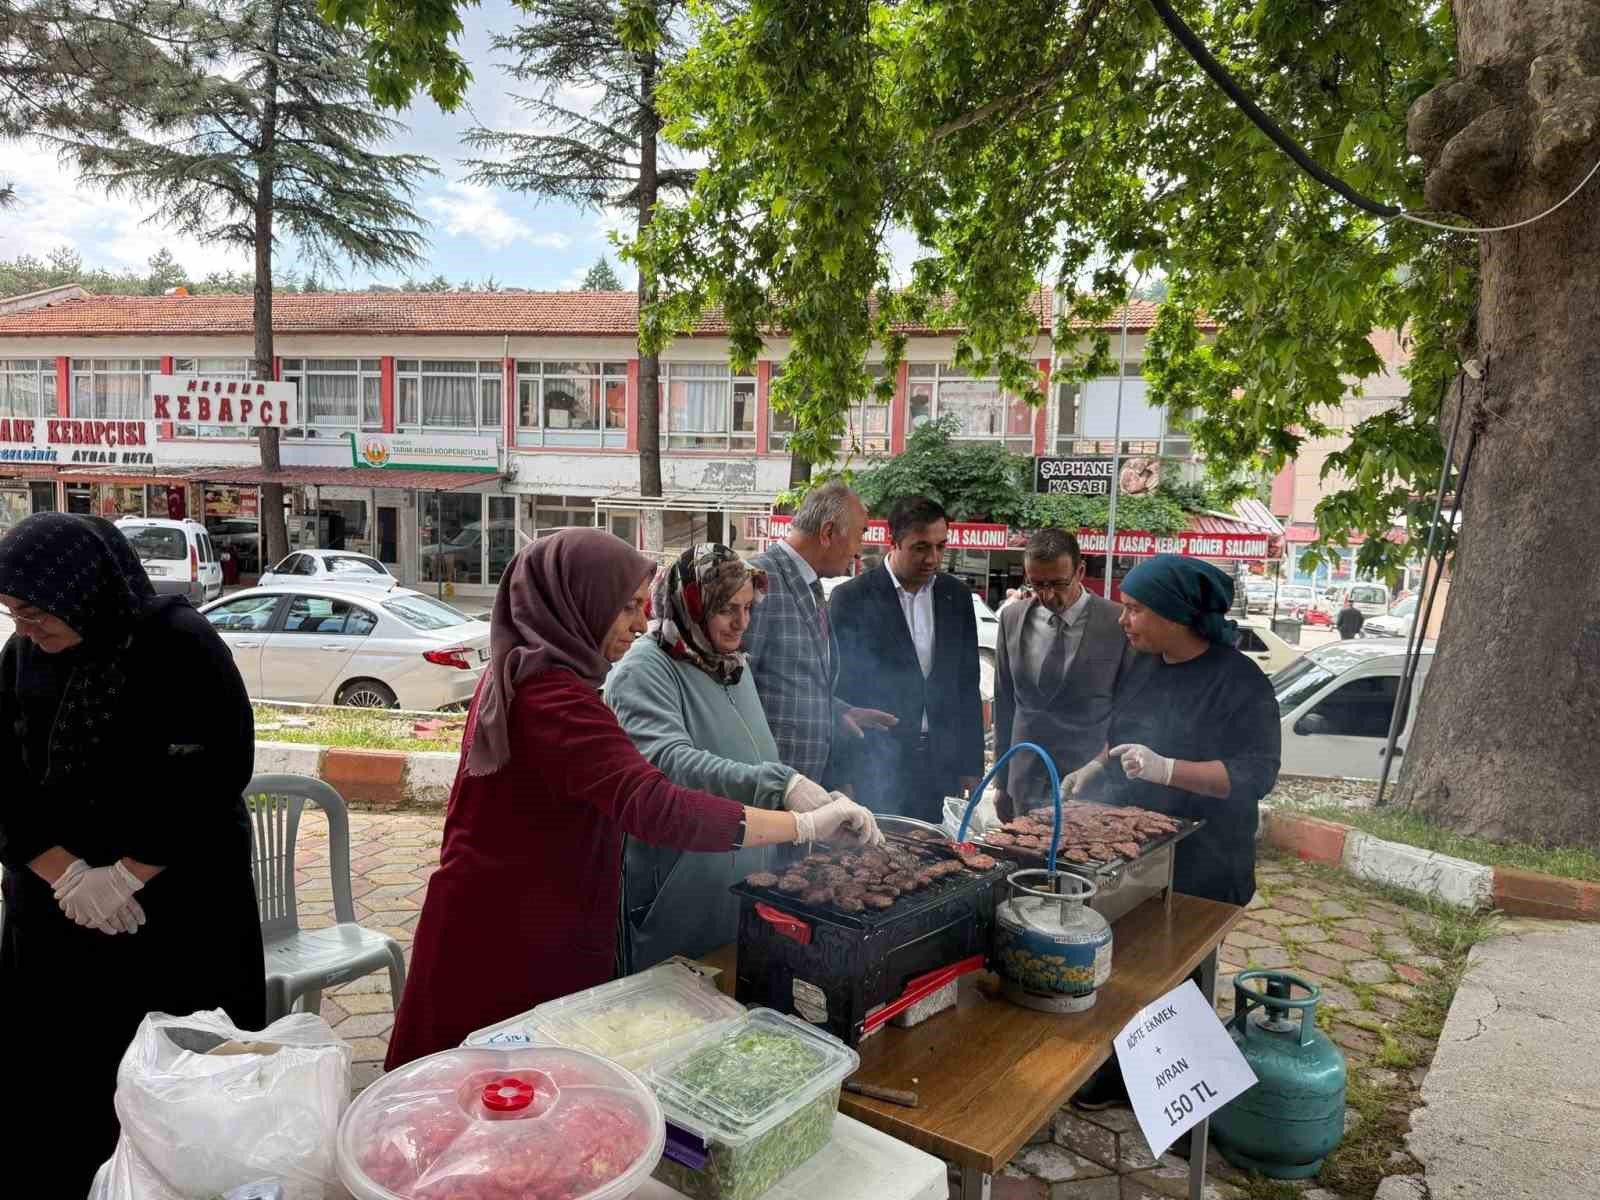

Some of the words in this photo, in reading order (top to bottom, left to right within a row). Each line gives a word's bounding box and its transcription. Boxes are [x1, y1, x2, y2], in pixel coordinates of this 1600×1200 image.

[187, 380, 265, 395] MEŞHUR
[154, 394, 288, 425] KEBAPÇI
[47, 419, 146, 447] KEBAPÇISI
[122, 452, 153, 464] USTA
[1040, 461, 1113, 479] ŞAPHANE
[962, 530, 1005, 546] SALONU
[1189, 536, 1223, 555] DÖNER
[1226, 539, 1266, 556] SALONU
[1145, 1004, 1178, 1033] EKMEK
[1155, 1057, 1190, 1090] AYRAN
[1163, 1093, 1193, 1127] 150
[1190, 1080, 1218, 1103] TL
